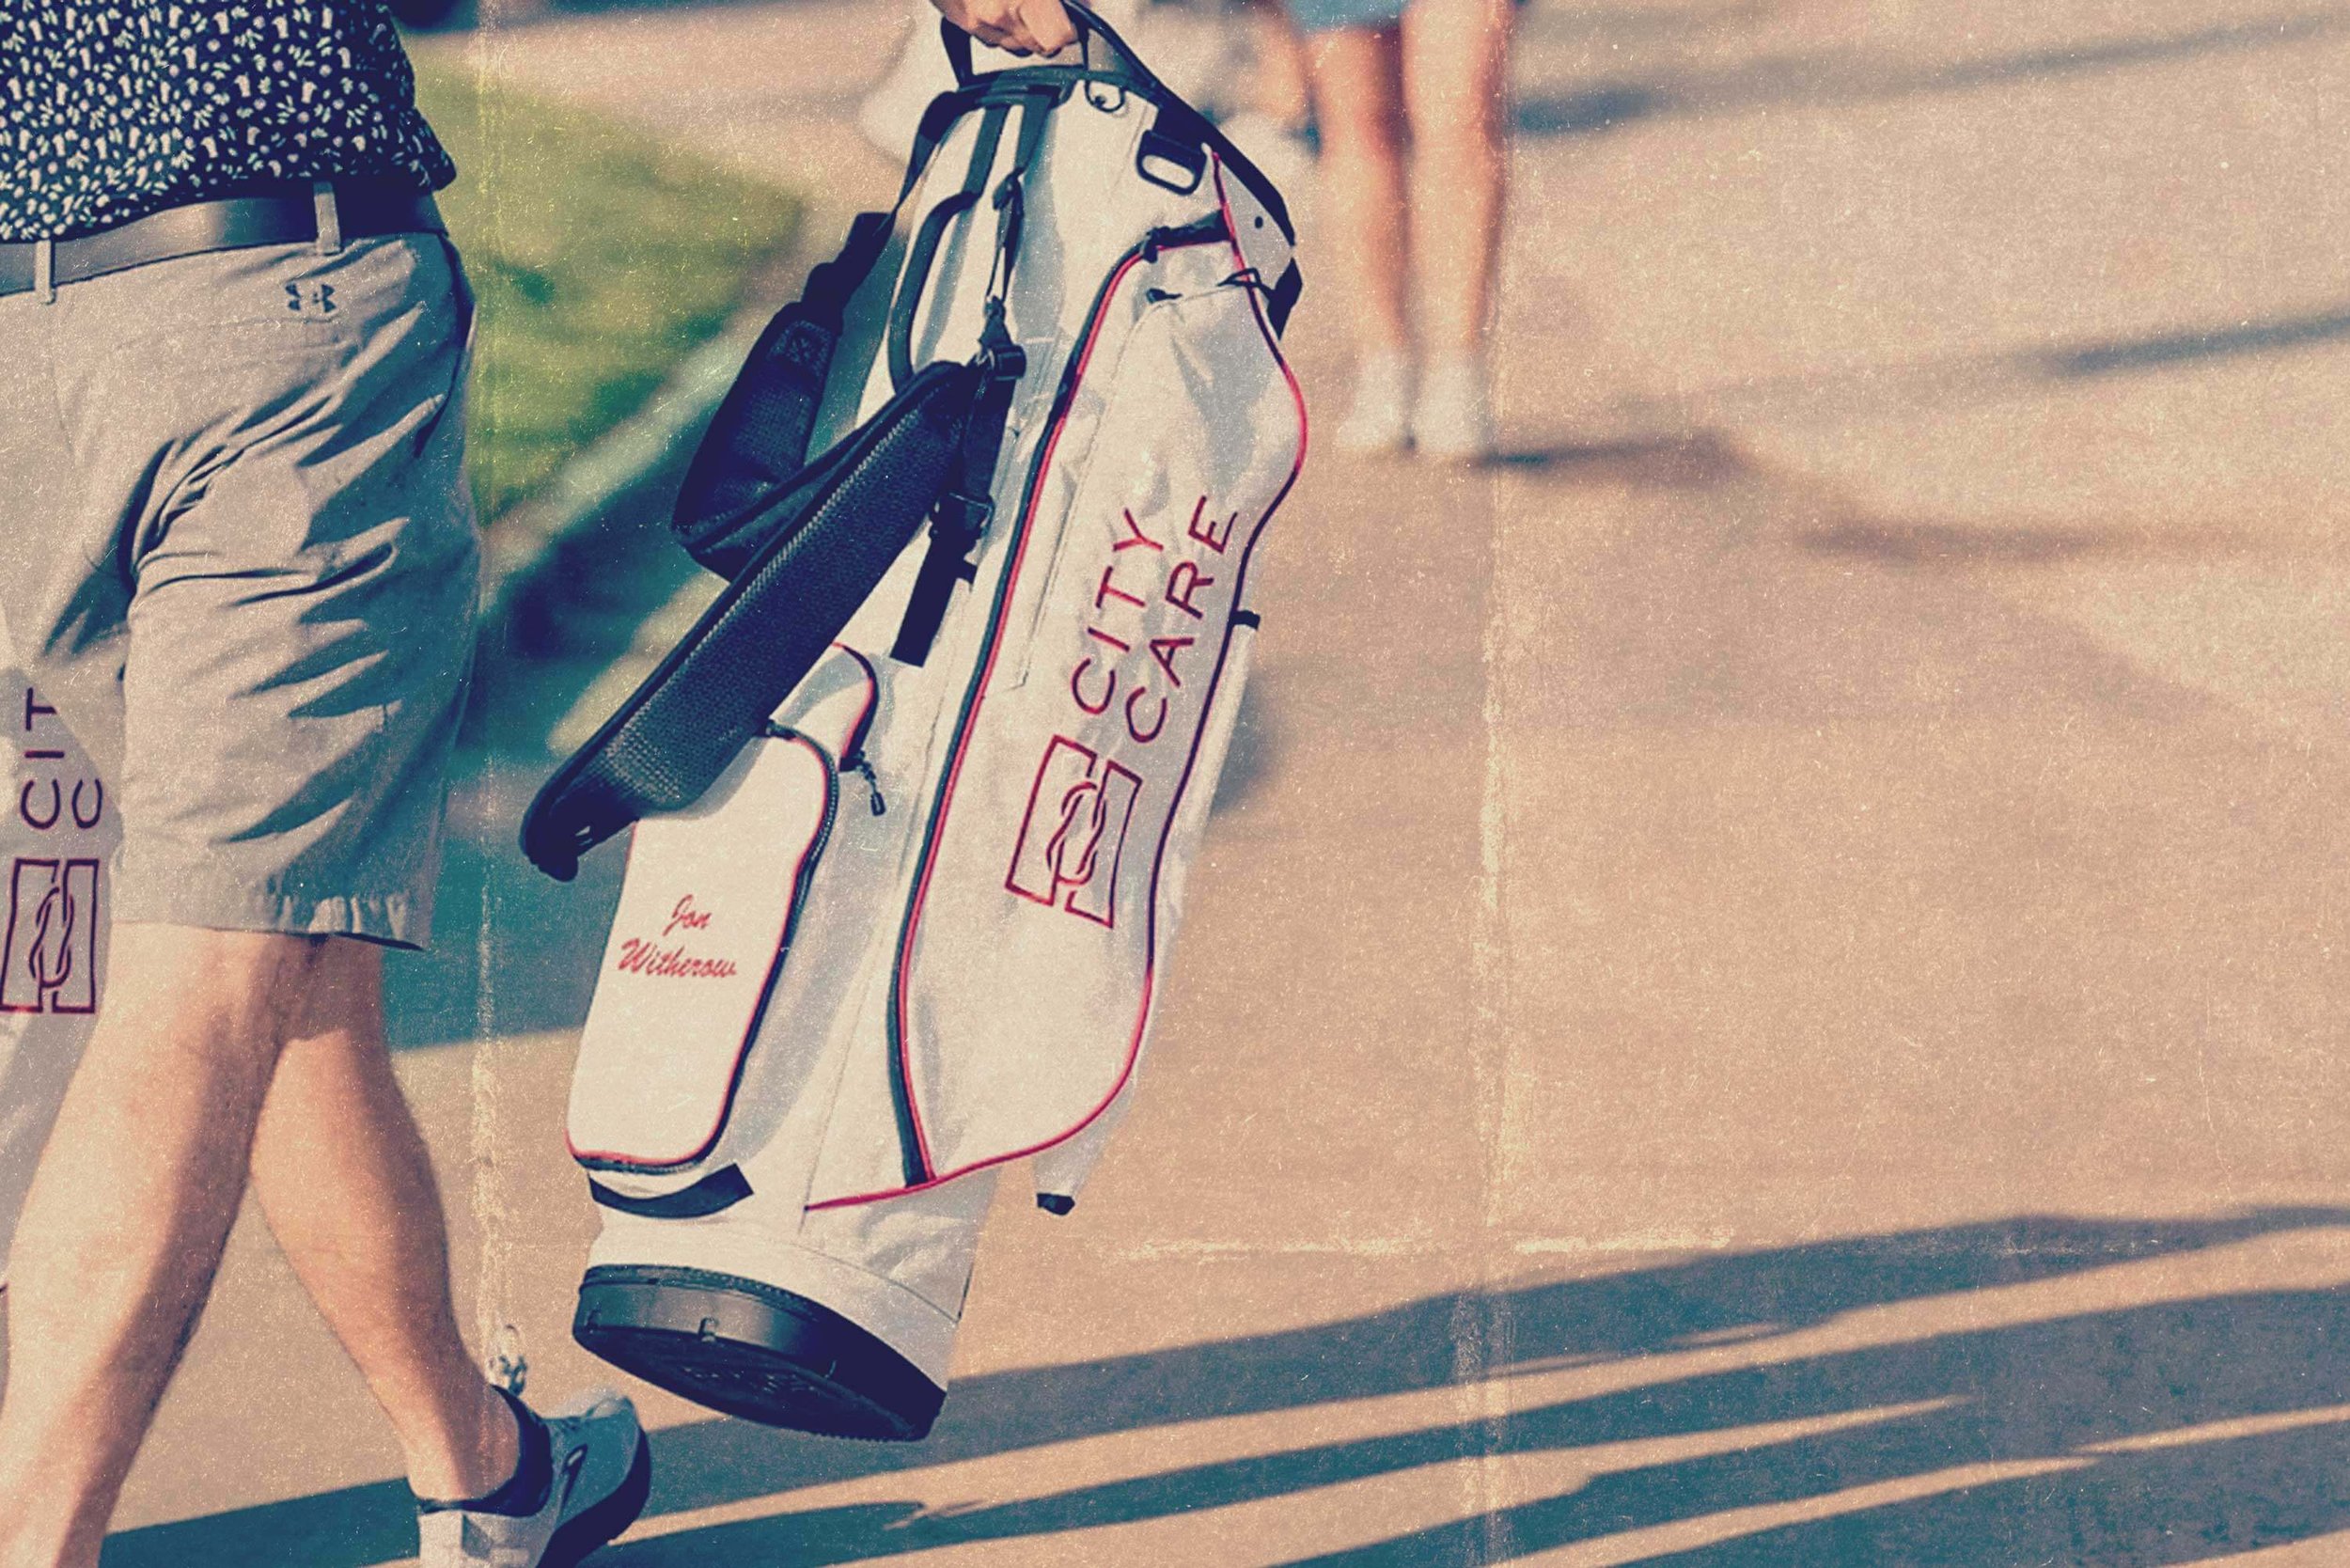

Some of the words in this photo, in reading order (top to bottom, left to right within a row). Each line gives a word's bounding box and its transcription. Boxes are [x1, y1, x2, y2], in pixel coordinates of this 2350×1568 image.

[1072, 509, 1164, 713] CITY
[1126, 496, 1238, 743] CARE
[21, 687, 65, 829] CIT
[619, 938, 737, 978] Witherow
[662, 894, 712, 936] Jon
